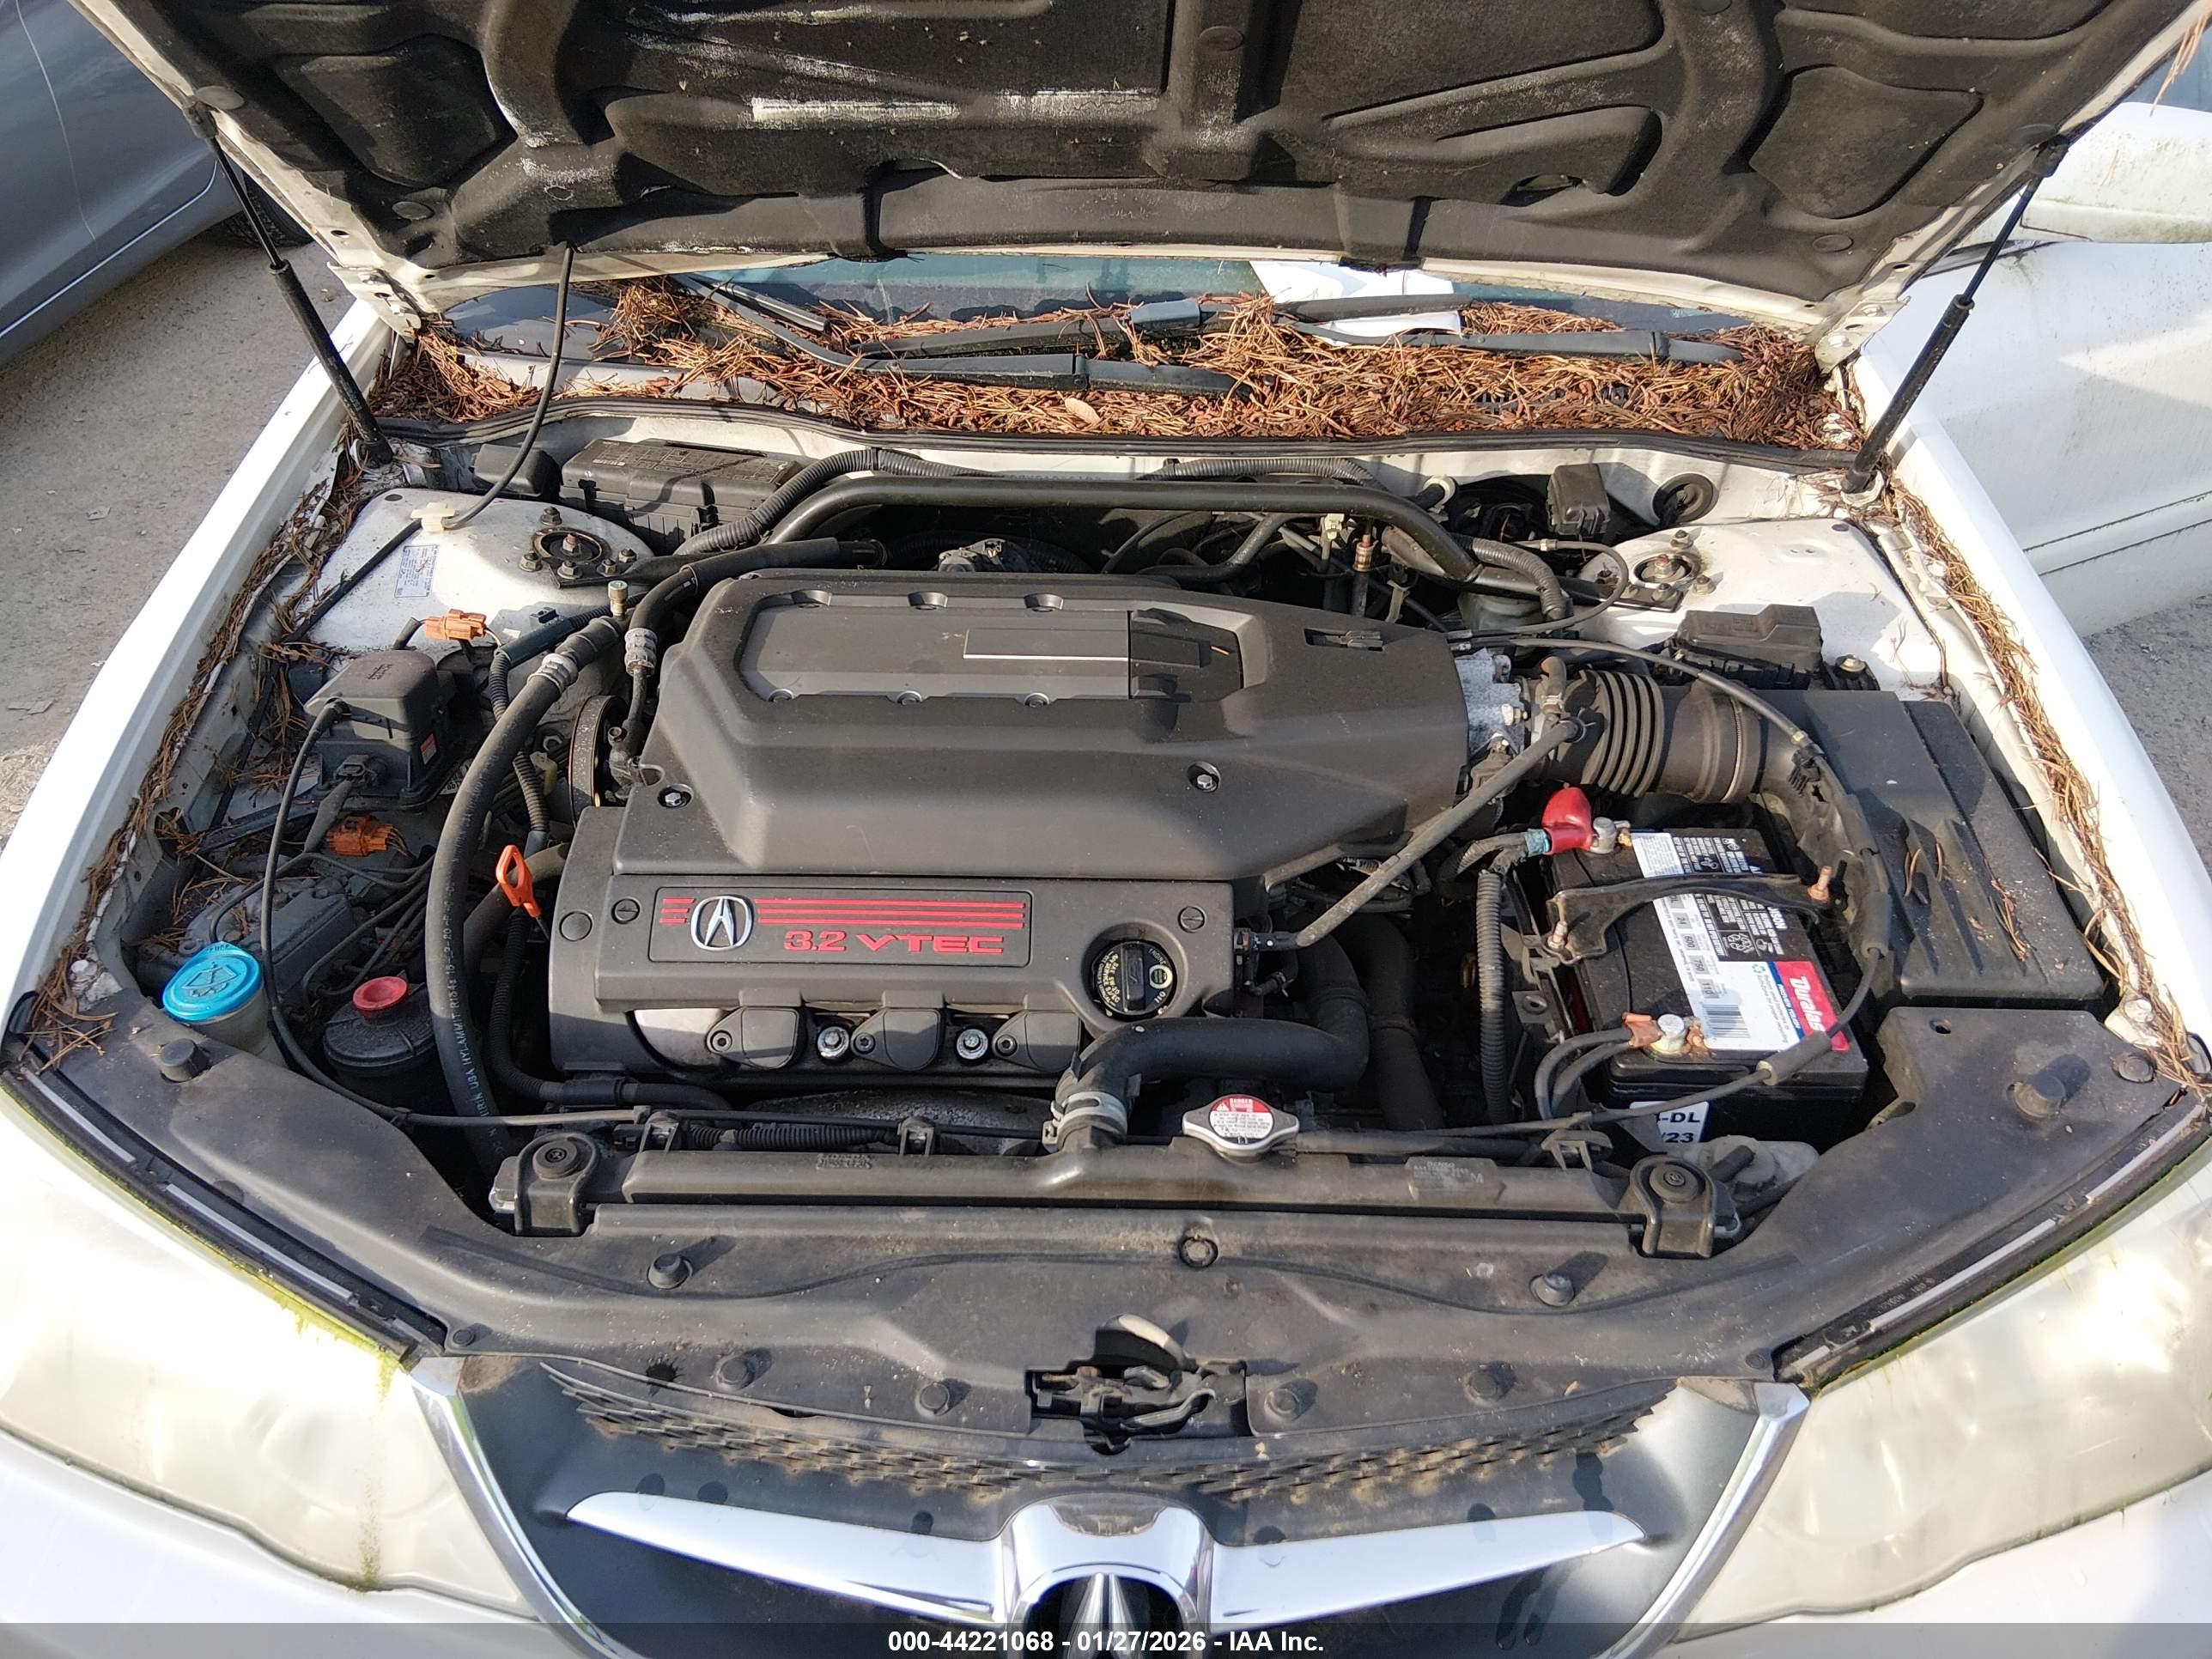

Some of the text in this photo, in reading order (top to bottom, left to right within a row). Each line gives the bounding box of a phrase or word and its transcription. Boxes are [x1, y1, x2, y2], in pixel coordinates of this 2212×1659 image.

[784, 930, 1005, 953] 3.2 VTEC
[1684, 935, 1695, 948] 600
[1693, 959, 1705, 971] 750
[1154, 991, 1166, 1003] OIL
[465, 1068, 480, 1090] USA
[1656, 1112, 1700, 1123] -DL
